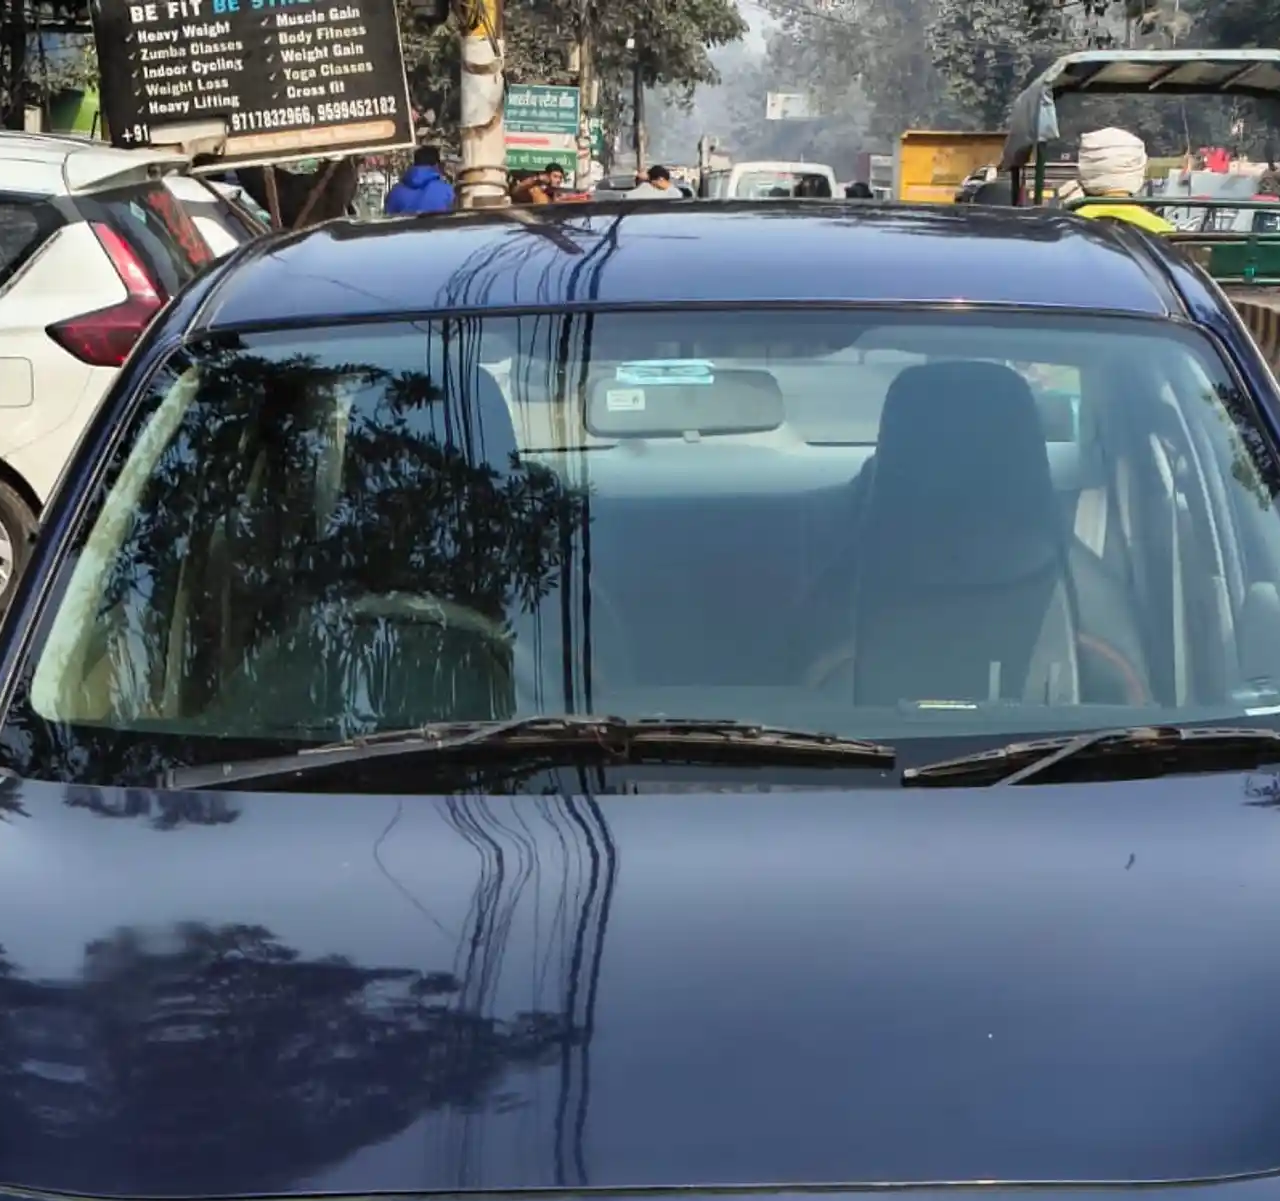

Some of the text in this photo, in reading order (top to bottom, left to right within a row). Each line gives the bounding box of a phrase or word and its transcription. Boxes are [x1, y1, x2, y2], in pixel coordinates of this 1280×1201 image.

[130, 4, 158, 24] BE
[167, 0, 202, 18] FIT
[276, 5, 360, 27] Muscle Gain
[137, 20, 230, 44] Heavy Weight
[278, 24, 367, 45] Body Fitness
[140, 41, 243, 61] Zumba Classes
[280, 42, 364, 63] Weight Gain
[143, 57, 244, 79] Indoor Cycling
[283, 61, 373, 82] Yoga Classes
[146, 78, 229, 96] Weight Loss
[286, 85, 325, 99] Cross
[148, 93, 240, 114] Heavy Lifting
